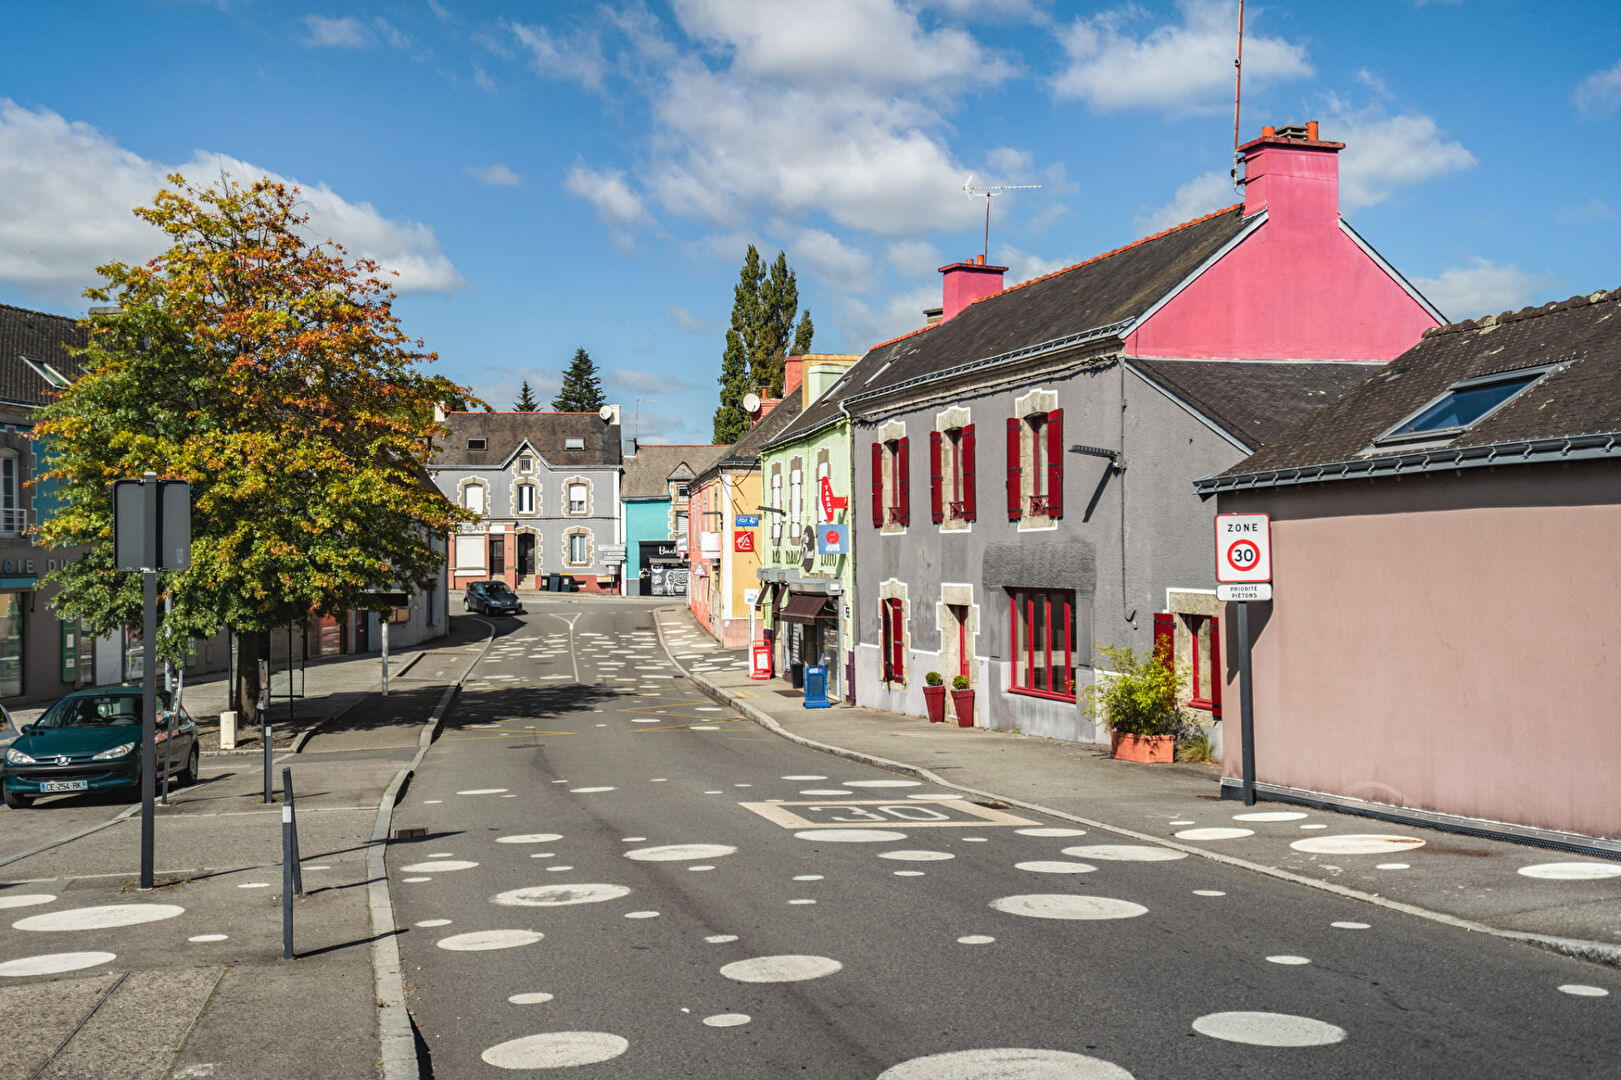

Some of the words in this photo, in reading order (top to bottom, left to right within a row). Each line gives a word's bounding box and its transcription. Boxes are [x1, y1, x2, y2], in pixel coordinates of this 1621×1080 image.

[824, 485, 832, 513] TABAC
[1227, 523, 1258, 532] ZONE
[1234, 549, 1253, 562] 30
[808, 805, 950, 822] 30
